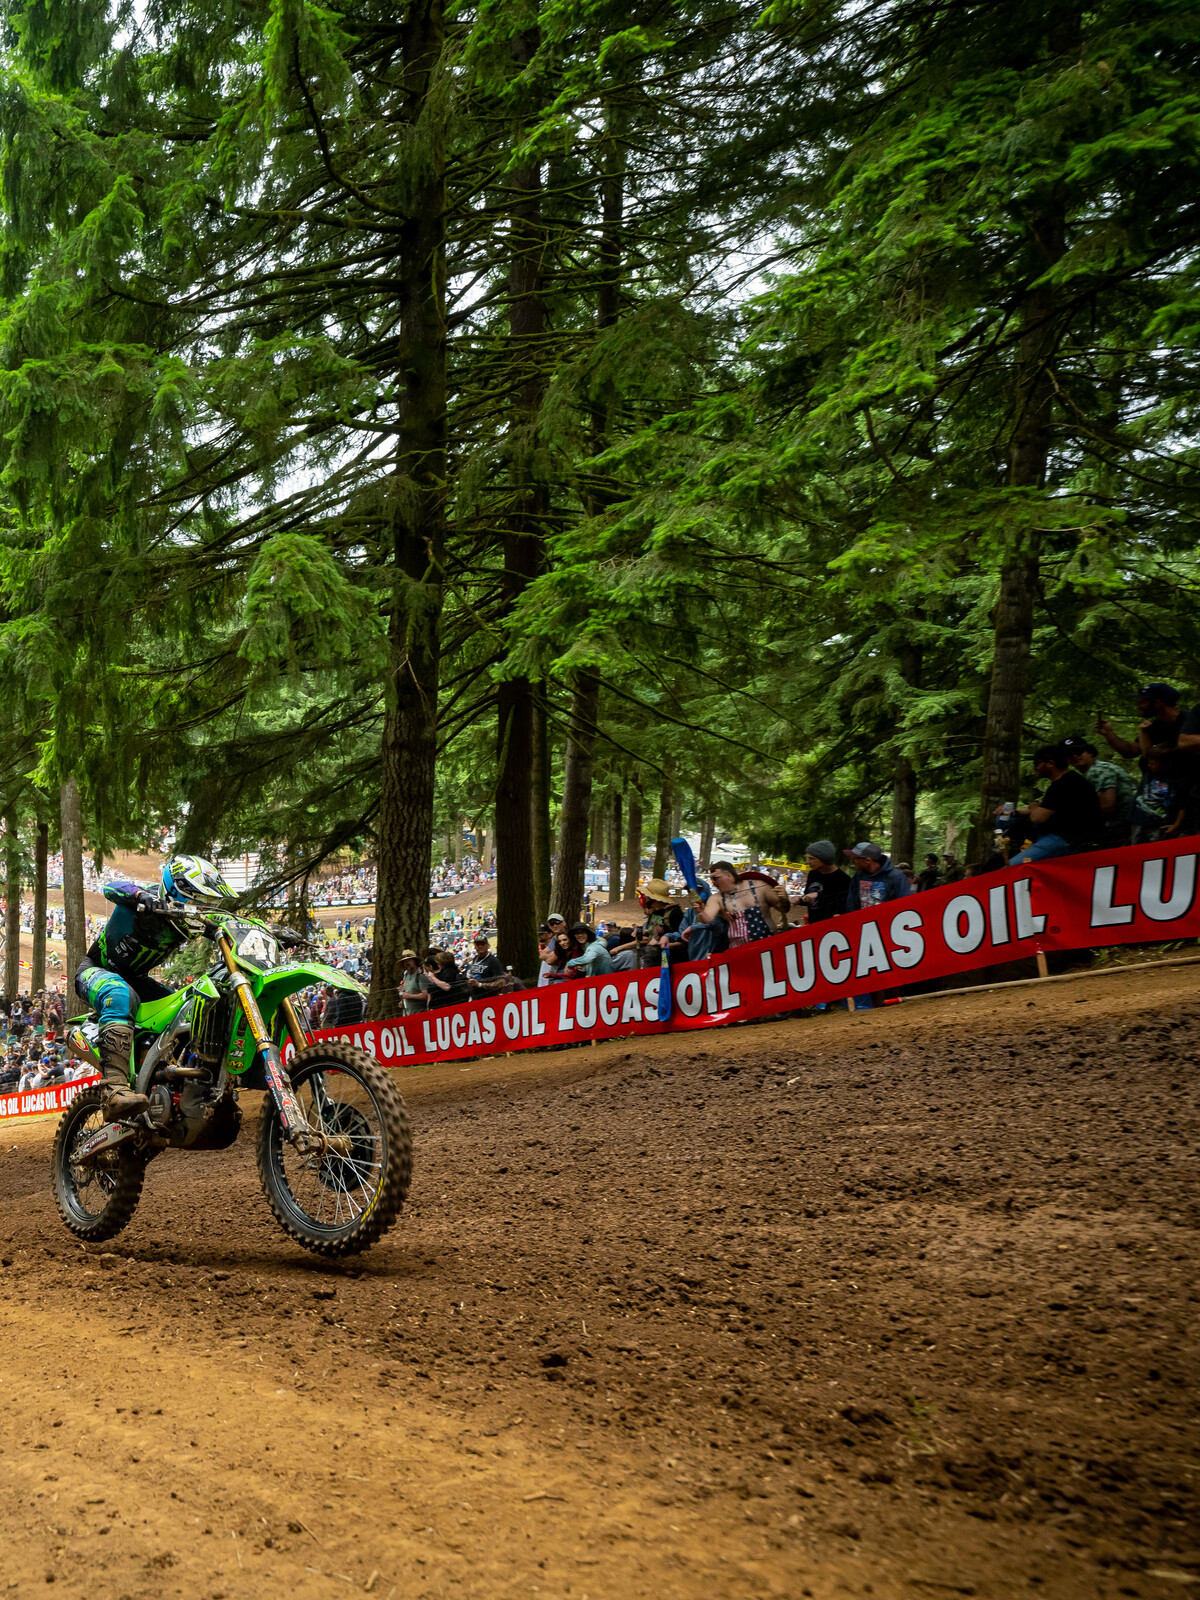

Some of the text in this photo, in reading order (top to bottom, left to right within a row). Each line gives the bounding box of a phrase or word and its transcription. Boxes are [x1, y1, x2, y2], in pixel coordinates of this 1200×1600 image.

[380, 1026, 416, 1058] OIL
[423, 1007, 496, 1053] LUCAS
[502, 998, 546, 1040] OIL
[558, 977, 662, 1032] LUCAS
[676, 963, 741, 1018] OIL
[761, 910, 926, 1000] LUCAS
[942, 878, 1047, 954] OIL
[1090, 853, 1200, 928] LU
[8, 1097, 19, 1115] OIL
[21, 1092, 45, 1113] LUCAS
[45, 1091, 58, 1110] OIL
